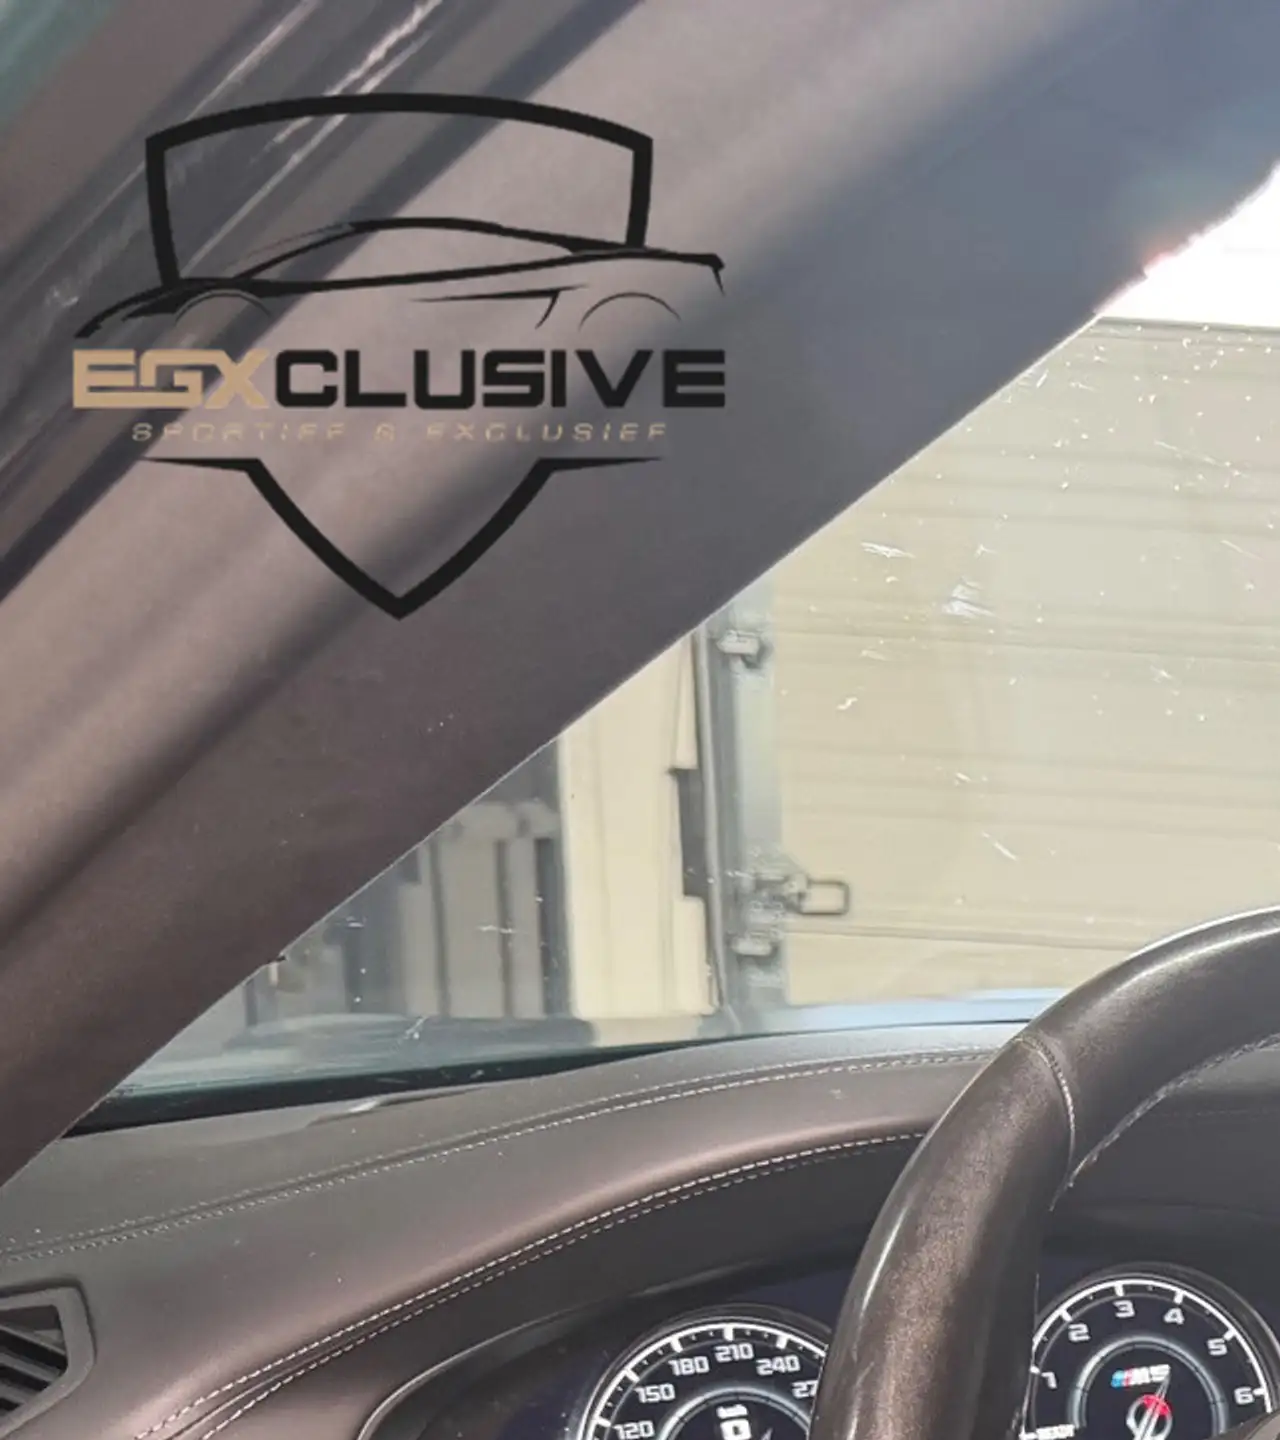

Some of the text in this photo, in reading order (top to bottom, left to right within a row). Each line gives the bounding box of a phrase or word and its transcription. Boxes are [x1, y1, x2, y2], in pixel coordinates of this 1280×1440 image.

[1113, 1300, 1135, 1318] 3
[1163, 1308, 1184, 1325] 4
[1068, 1323, 1090, 1342] 2
[714, 1343, 754, 1363] 210
[1207, 1338, 1228, 1356] 5
[668, 1356, 710, 1376] 180
[756, 1355, 801, 1376] 240
[1041, 1371, 1058, 1390] 1
[635, 1383, 676, 1403] 150
[1234, 1387, 1256, 1405] 6
[614, 1420, 655, 1440] 120
